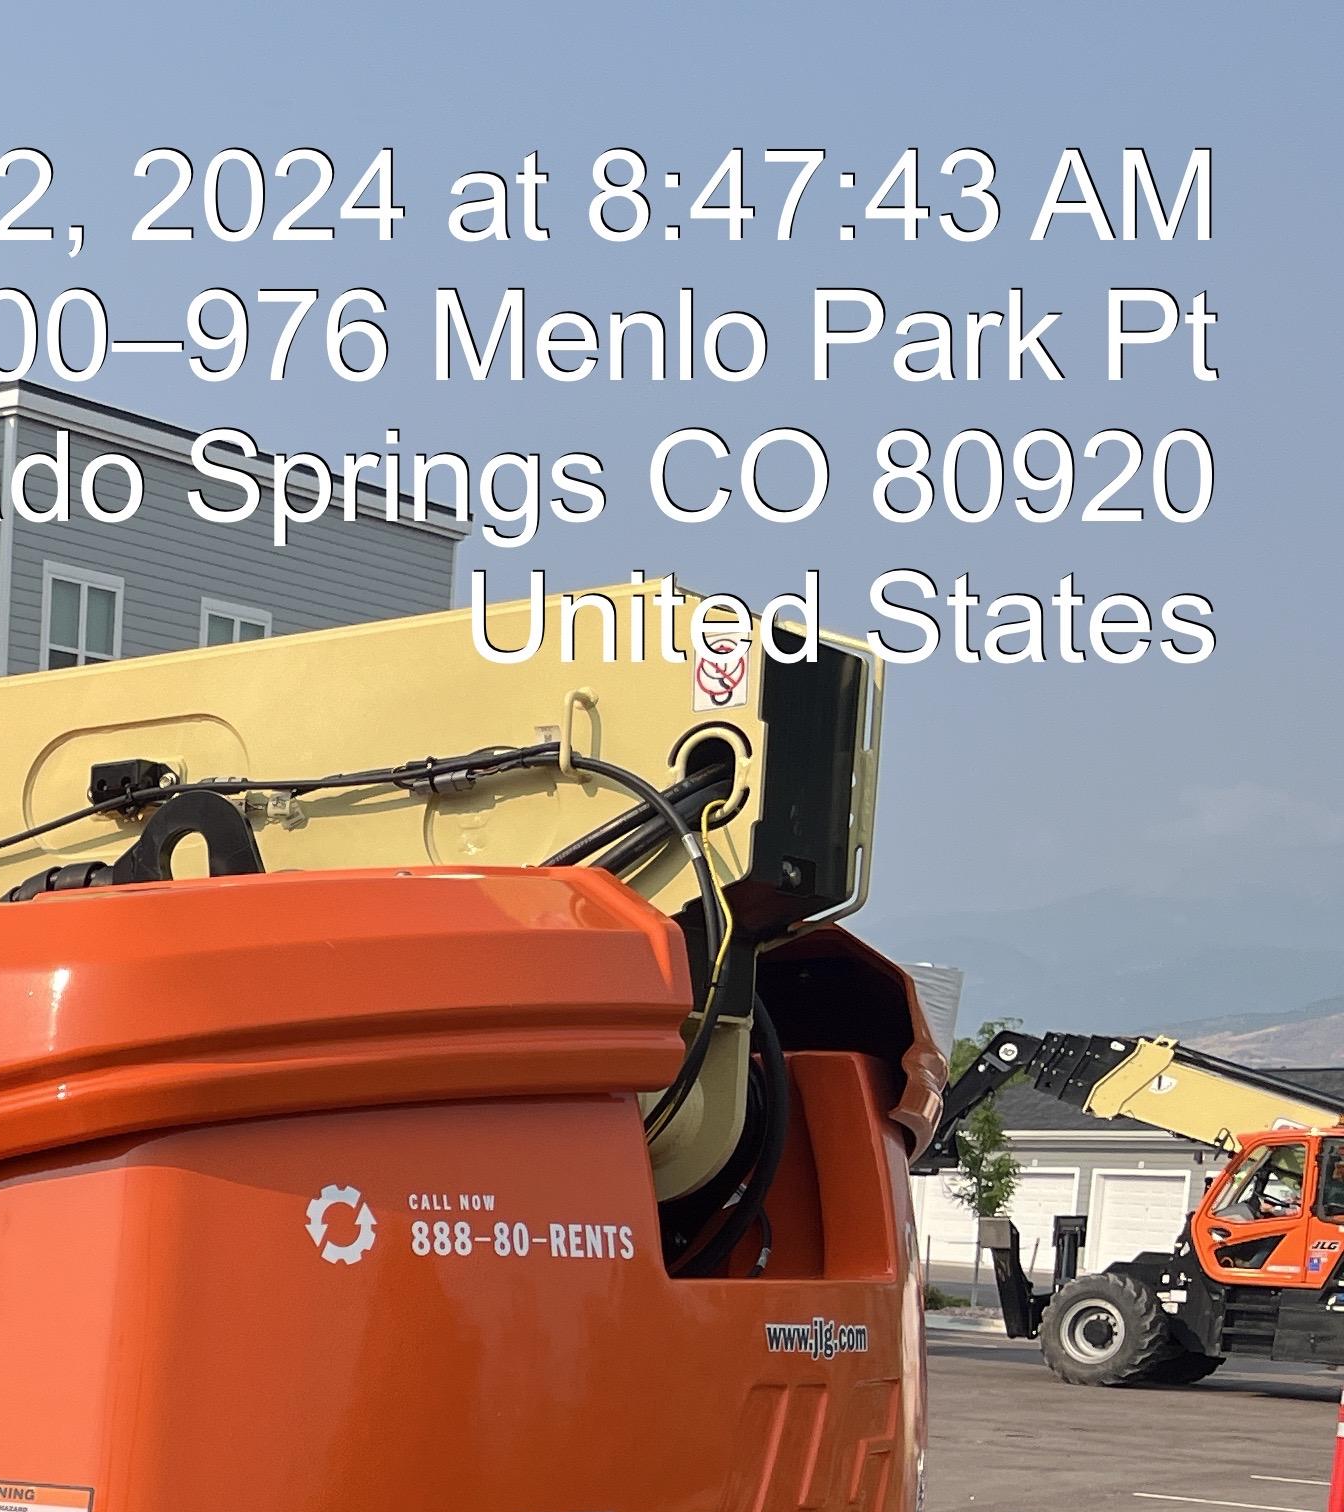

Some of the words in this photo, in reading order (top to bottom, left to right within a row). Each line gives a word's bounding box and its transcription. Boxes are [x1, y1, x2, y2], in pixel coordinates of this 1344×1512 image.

[408, 1193, 453, 1211] CALL
[459, 1194, 496, 1212] NOW
[410, 1219, 635, 1260] 888-80-RENTS
[1311, 1240, 1340, 1251] JLG
[766, 1317, 868, 1360] www.jlg.com
